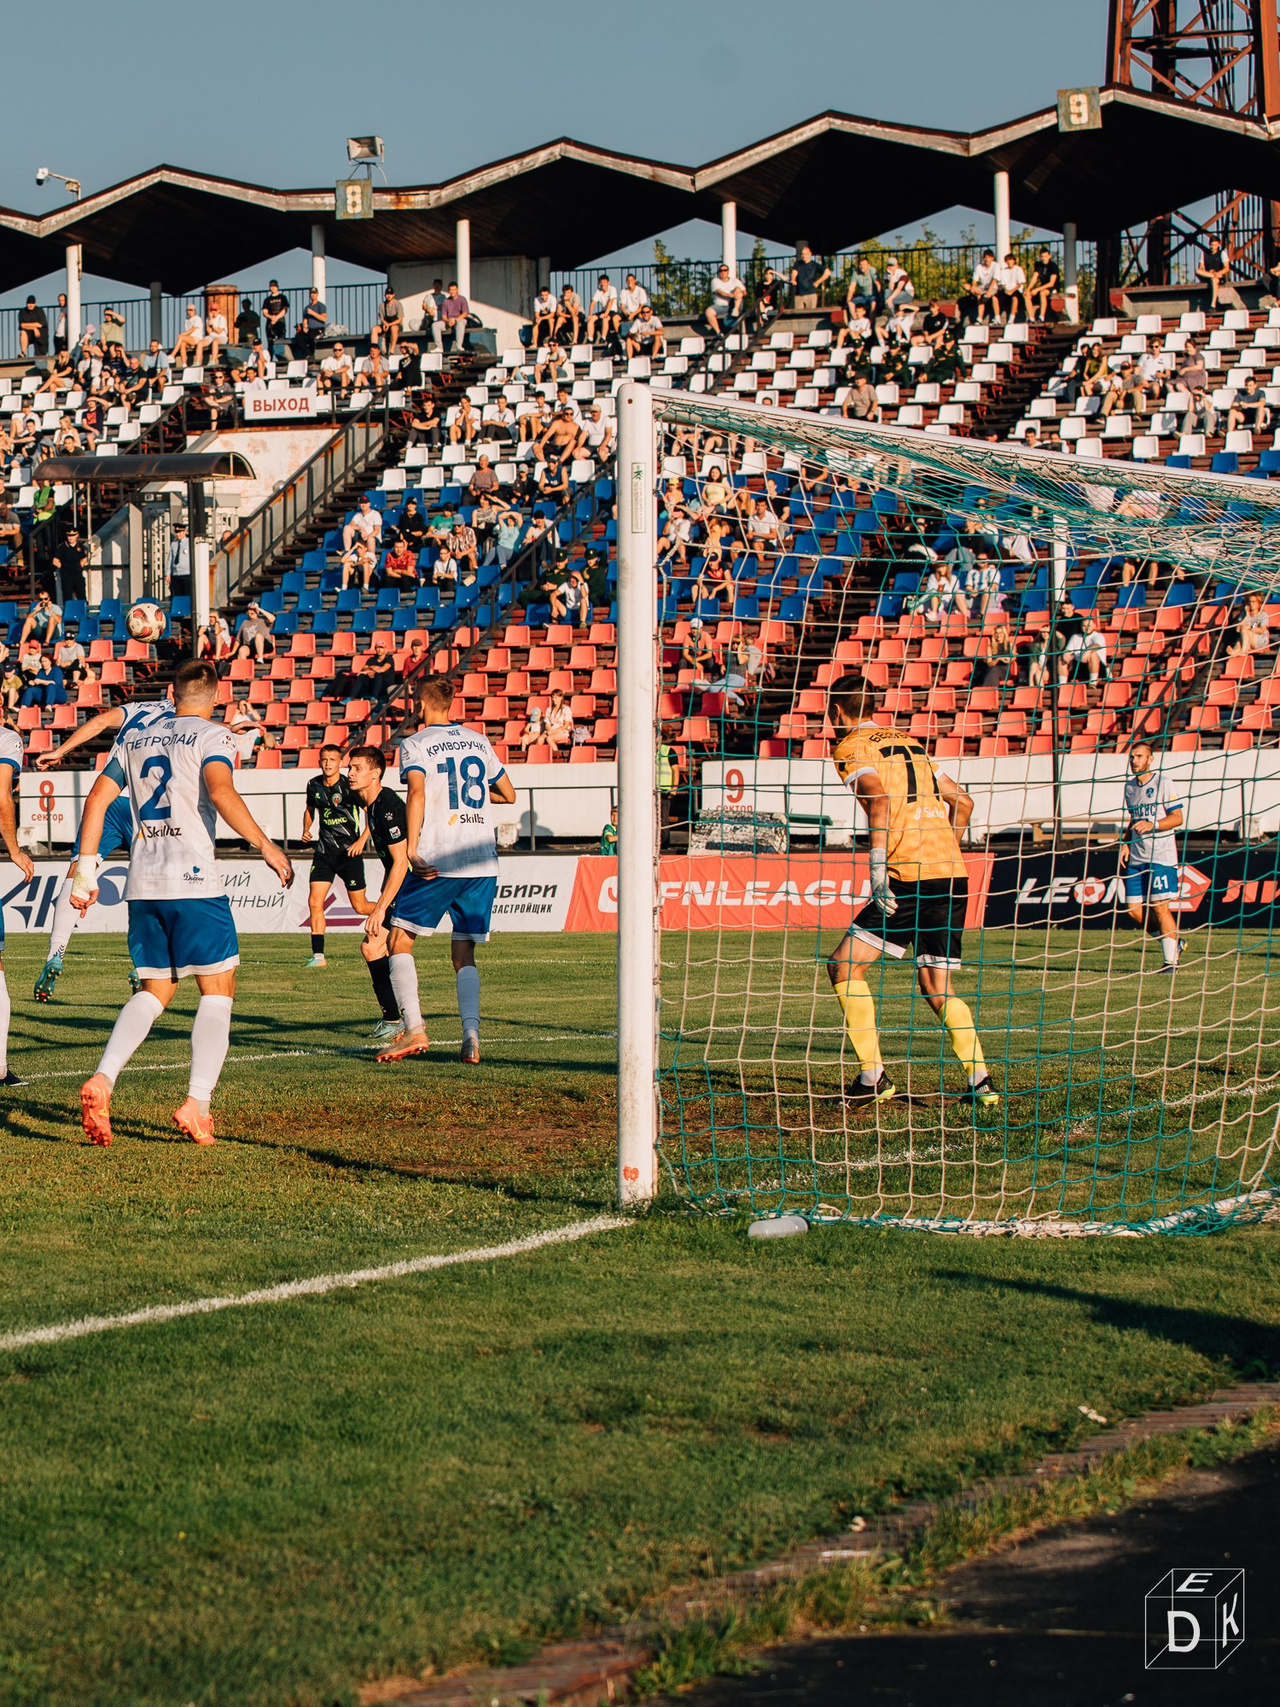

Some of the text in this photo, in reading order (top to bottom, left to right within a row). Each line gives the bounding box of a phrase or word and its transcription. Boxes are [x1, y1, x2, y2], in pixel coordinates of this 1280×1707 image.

[1069, 93, 1089, 125] 9
[346, 185, 362, 214] 8
[253, 397, 310, 413] ВЫХОД
[125, 732, 199, 752] ПЕТРОЛАЙ
[39, 780, 56, 812] 8
[139, 755, 173, 822] 2
[436, 755, 486, 810] 18
[725, 768, 745, 804] 9
[220, 871, 252, 888] ИЙ
[1153, 874, 1170, 890] 41
[491, 902, 553, 915] ЗАСТРОЙЩИК
